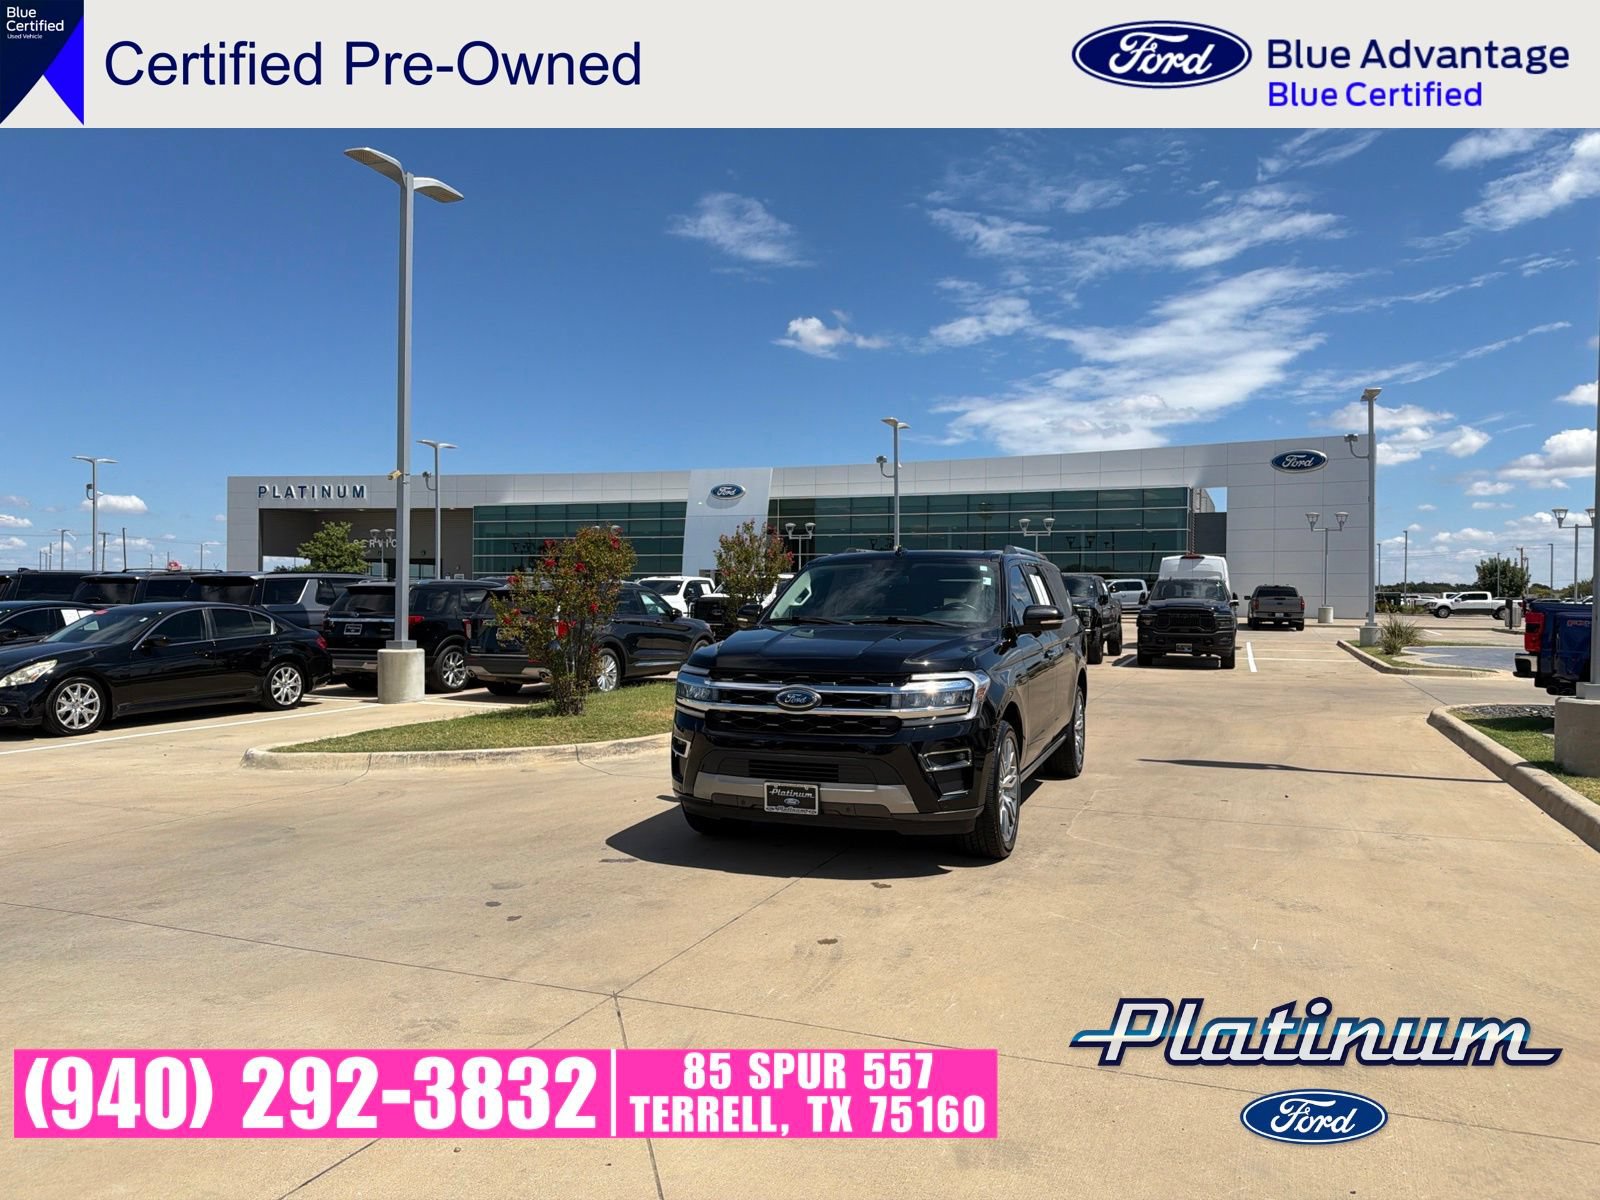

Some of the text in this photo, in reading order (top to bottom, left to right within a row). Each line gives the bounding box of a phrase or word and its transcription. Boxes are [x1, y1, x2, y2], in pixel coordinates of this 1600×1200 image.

[1281, 454, 1315, 468] Ford
[257, 484, 367, 500] PLATINUM
[716, 486, 737, 496] Ford
[784, 693, 808, 704] Ford
[769, 788, 815, 799] Platinum
